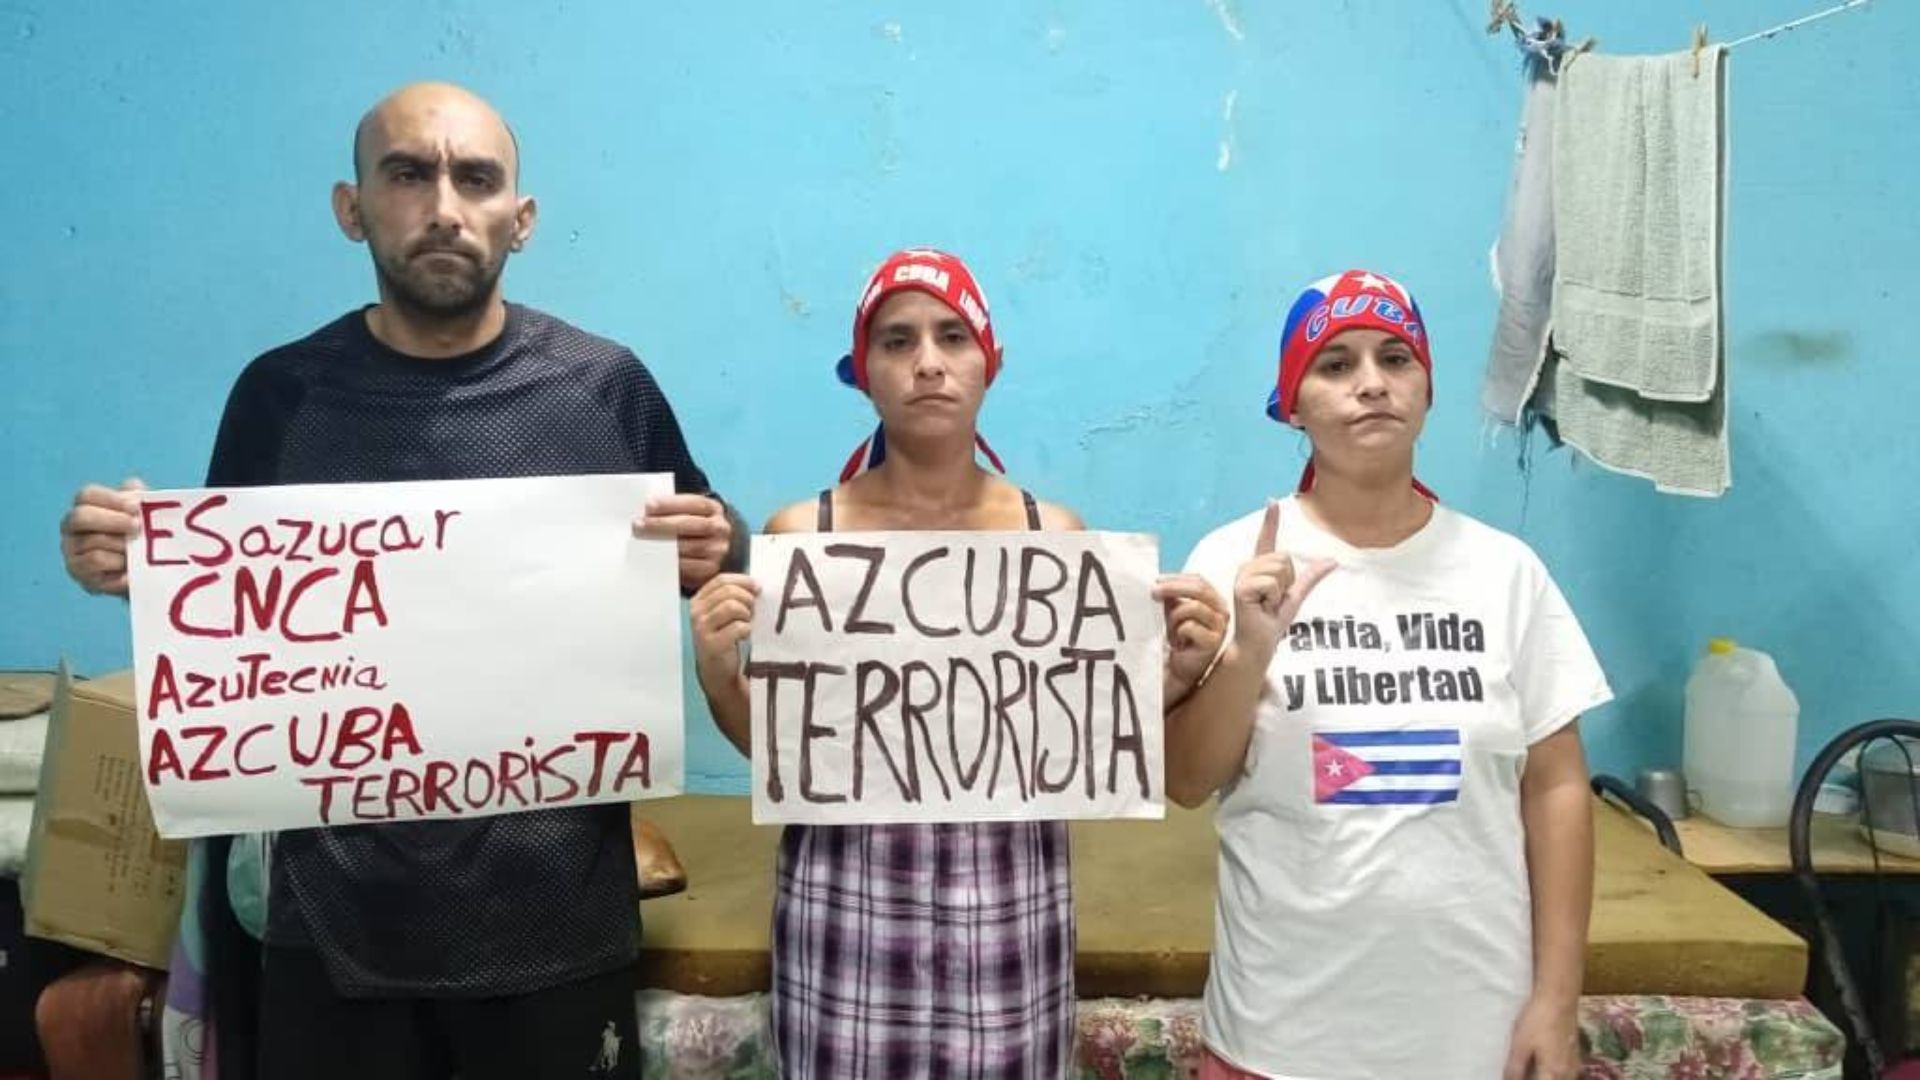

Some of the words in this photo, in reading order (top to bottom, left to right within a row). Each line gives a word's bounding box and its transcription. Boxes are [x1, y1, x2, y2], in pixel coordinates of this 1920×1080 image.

[893, 264, 950, 292] CUBA
[169, 560, 387, 642] CNCA
[775, 543, 1126, 648] AZCUBA
[1284, 614, 1391, 653] atria,
[1396, 612, 1485, 653] Vida
[744, 647, 1151, 803] TERRORISTA
[1283, 673, 1306, 712] y
[1314, 664, 1485, 706] Libertad
[148, 702, 424, 786] AZCUBA
